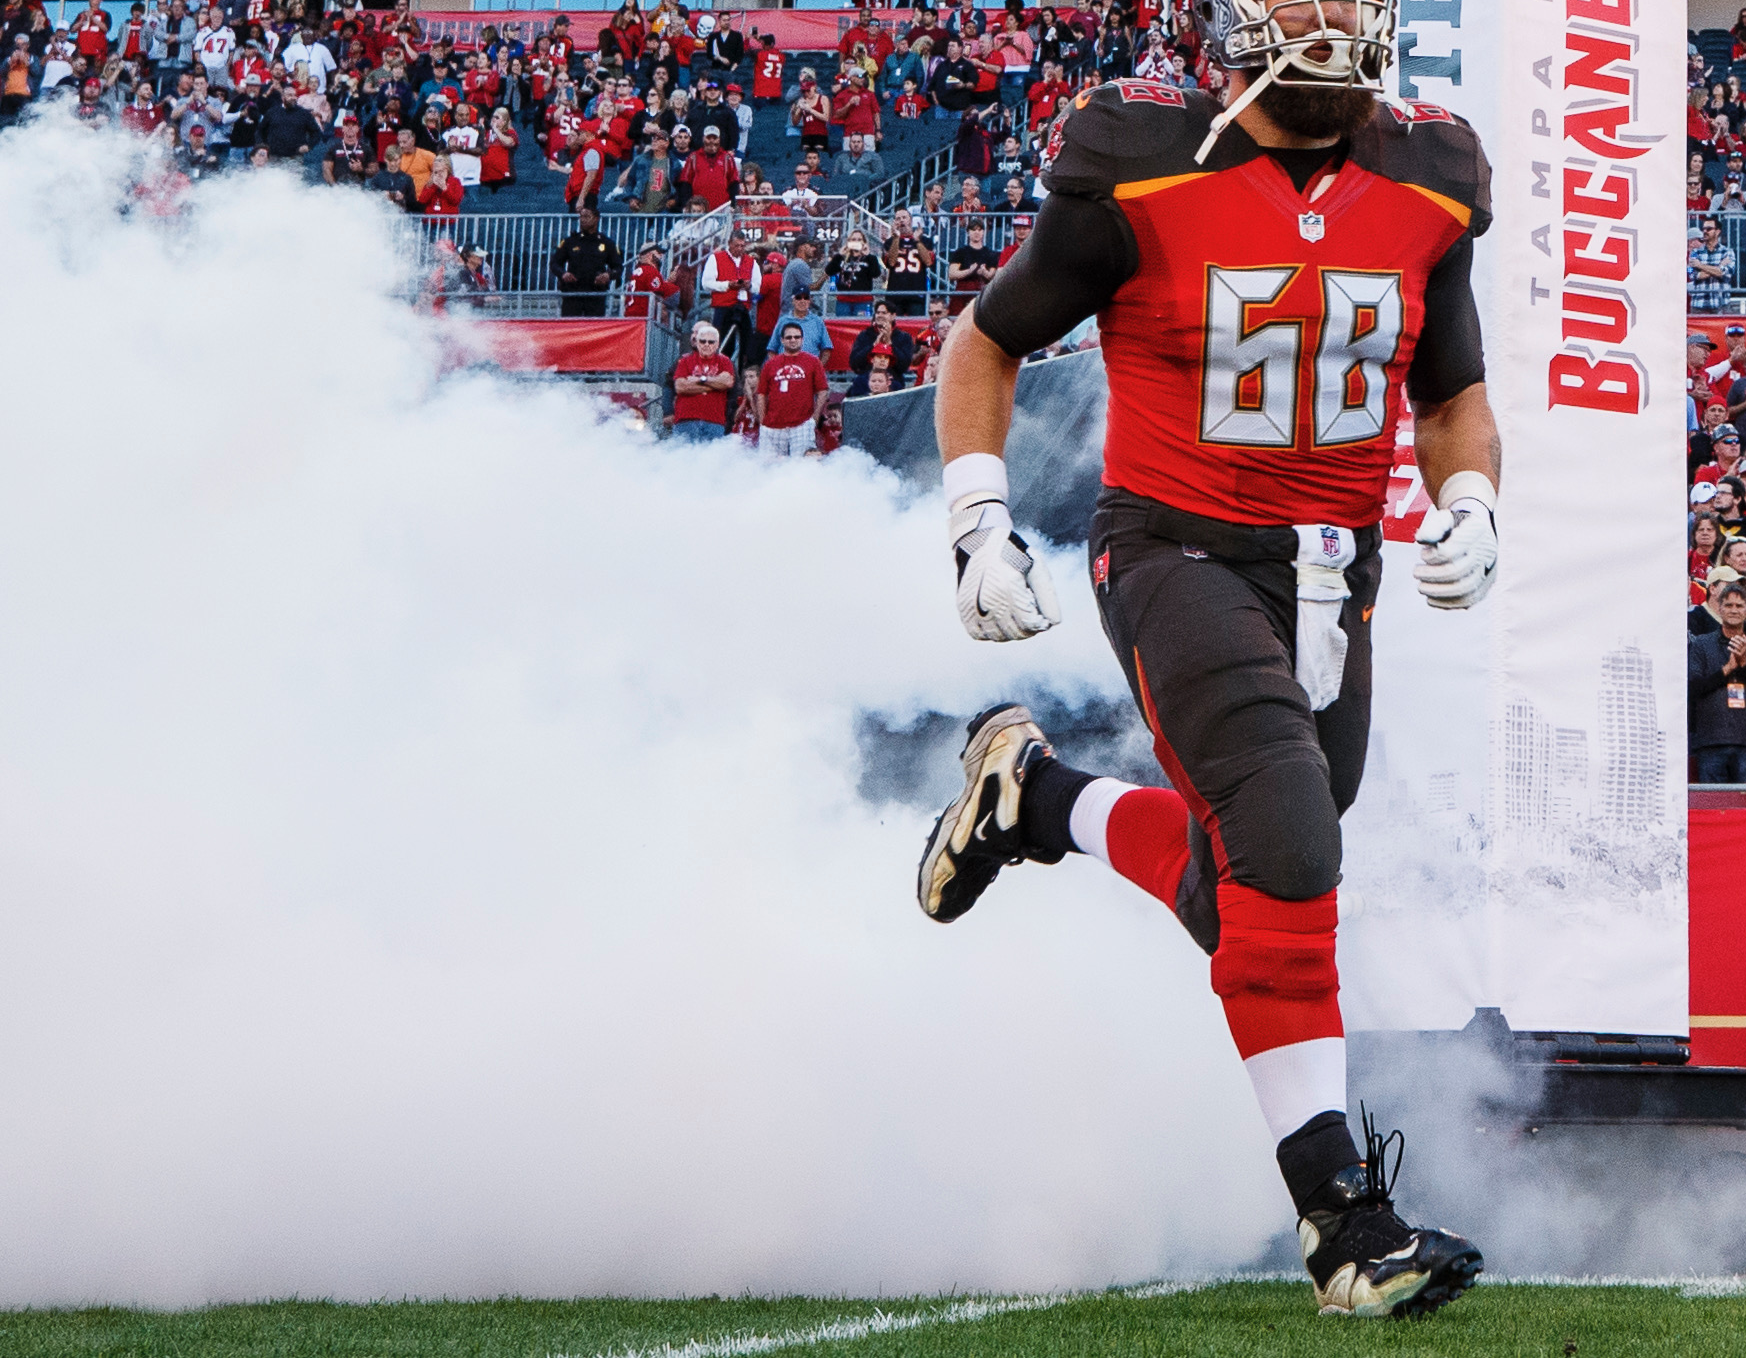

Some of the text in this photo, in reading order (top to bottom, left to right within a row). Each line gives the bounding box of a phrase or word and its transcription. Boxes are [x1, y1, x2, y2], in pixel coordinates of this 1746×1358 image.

[203, 37, 228, 54] 47
[763, 61, 783, 79] 23
[650, 168, 663, 192] 3
[1531, 53, 1554, 306] TAMPA
[816, 227, 840, 239] 214
[1197, 261, 1406, 451] 68
